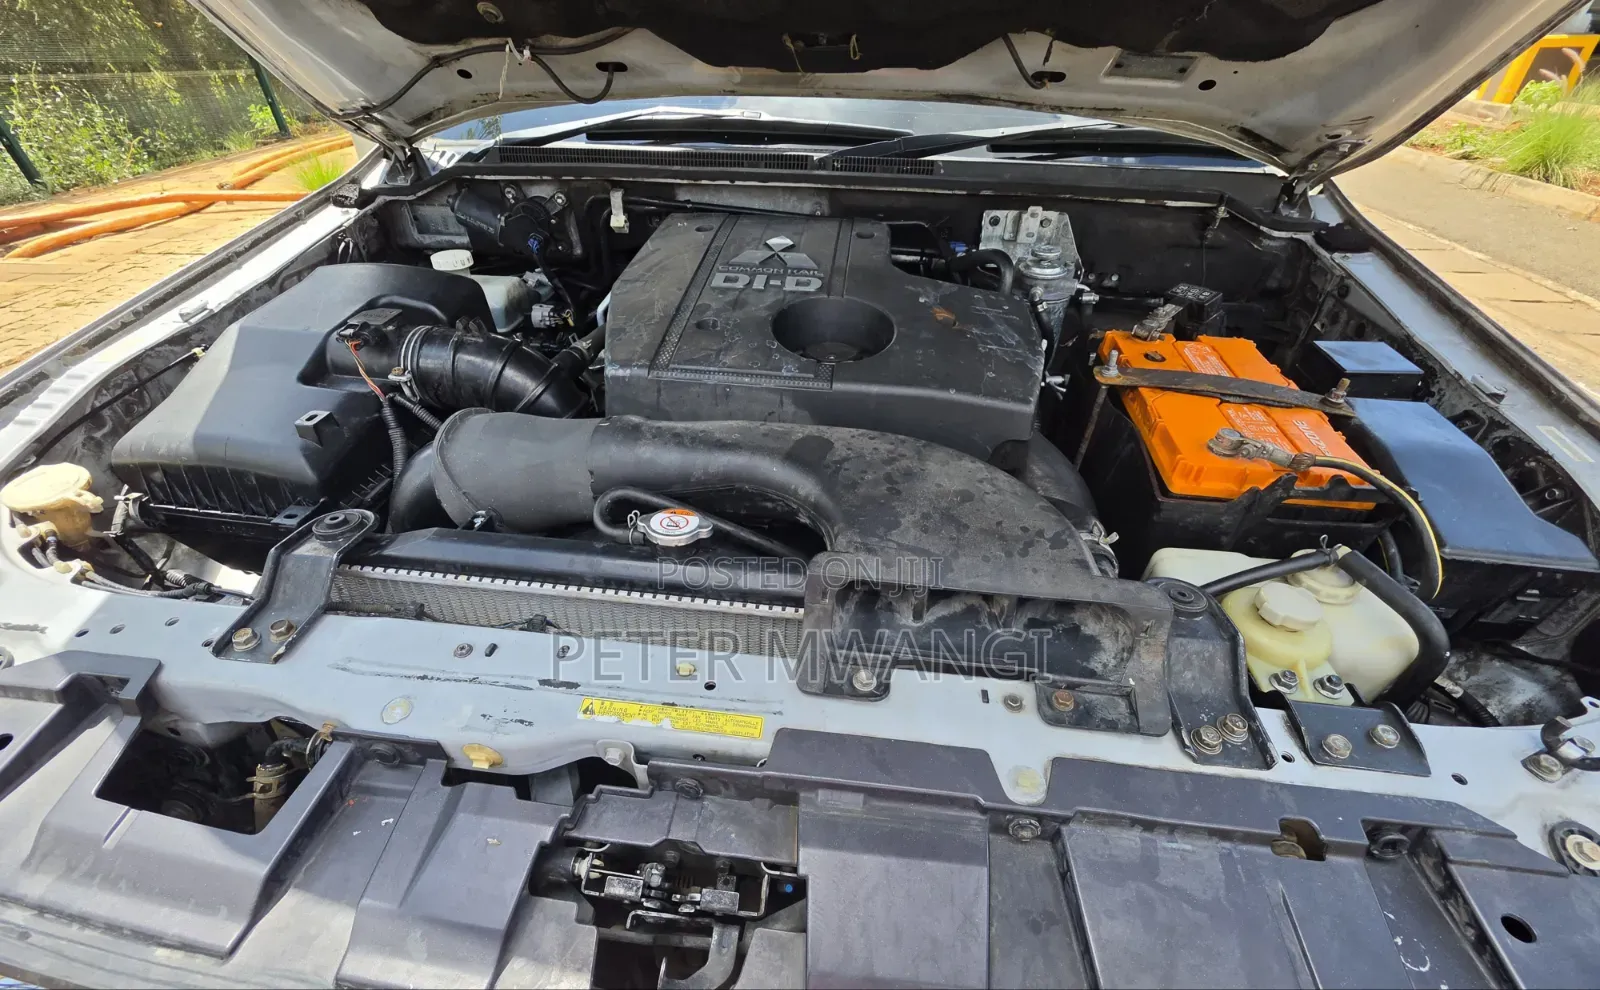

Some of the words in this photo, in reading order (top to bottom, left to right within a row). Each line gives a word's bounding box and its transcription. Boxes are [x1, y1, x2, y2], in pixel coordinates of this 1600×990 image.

[718, 265, 784, 274] COMMON
[787, 268, 824, 277] RAIL
[710, 273, 823, 291] DI-D
